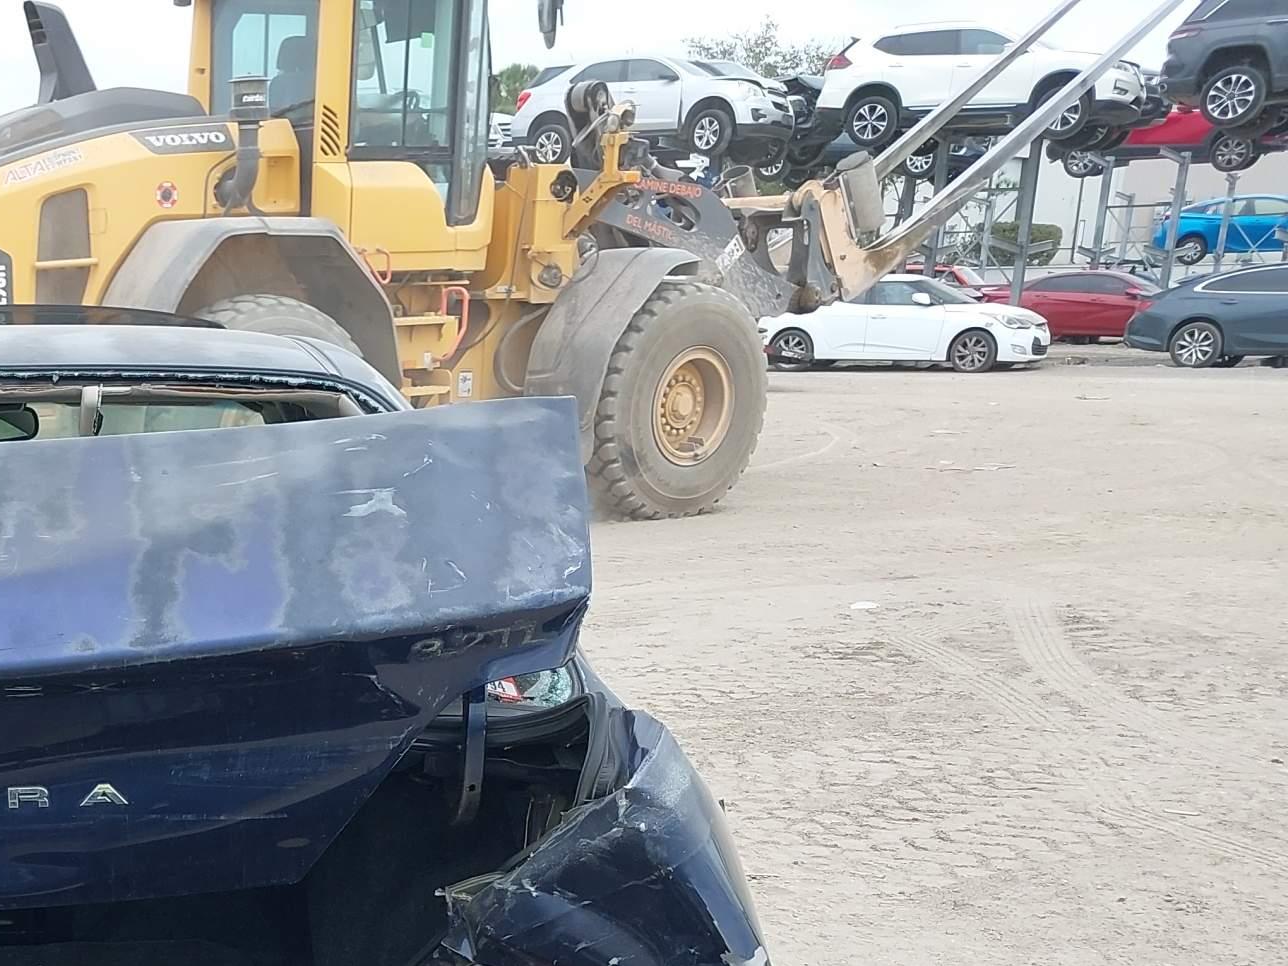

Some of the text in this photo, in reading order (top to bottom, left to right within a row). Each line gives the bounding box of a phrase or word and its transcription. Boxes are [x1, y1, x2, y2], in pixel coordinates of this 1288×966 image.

[145, 132, 226, 147] VOLVO
[669, 183, 702, 197] DEBAJO
[626, 214, 642, 229] DEL
